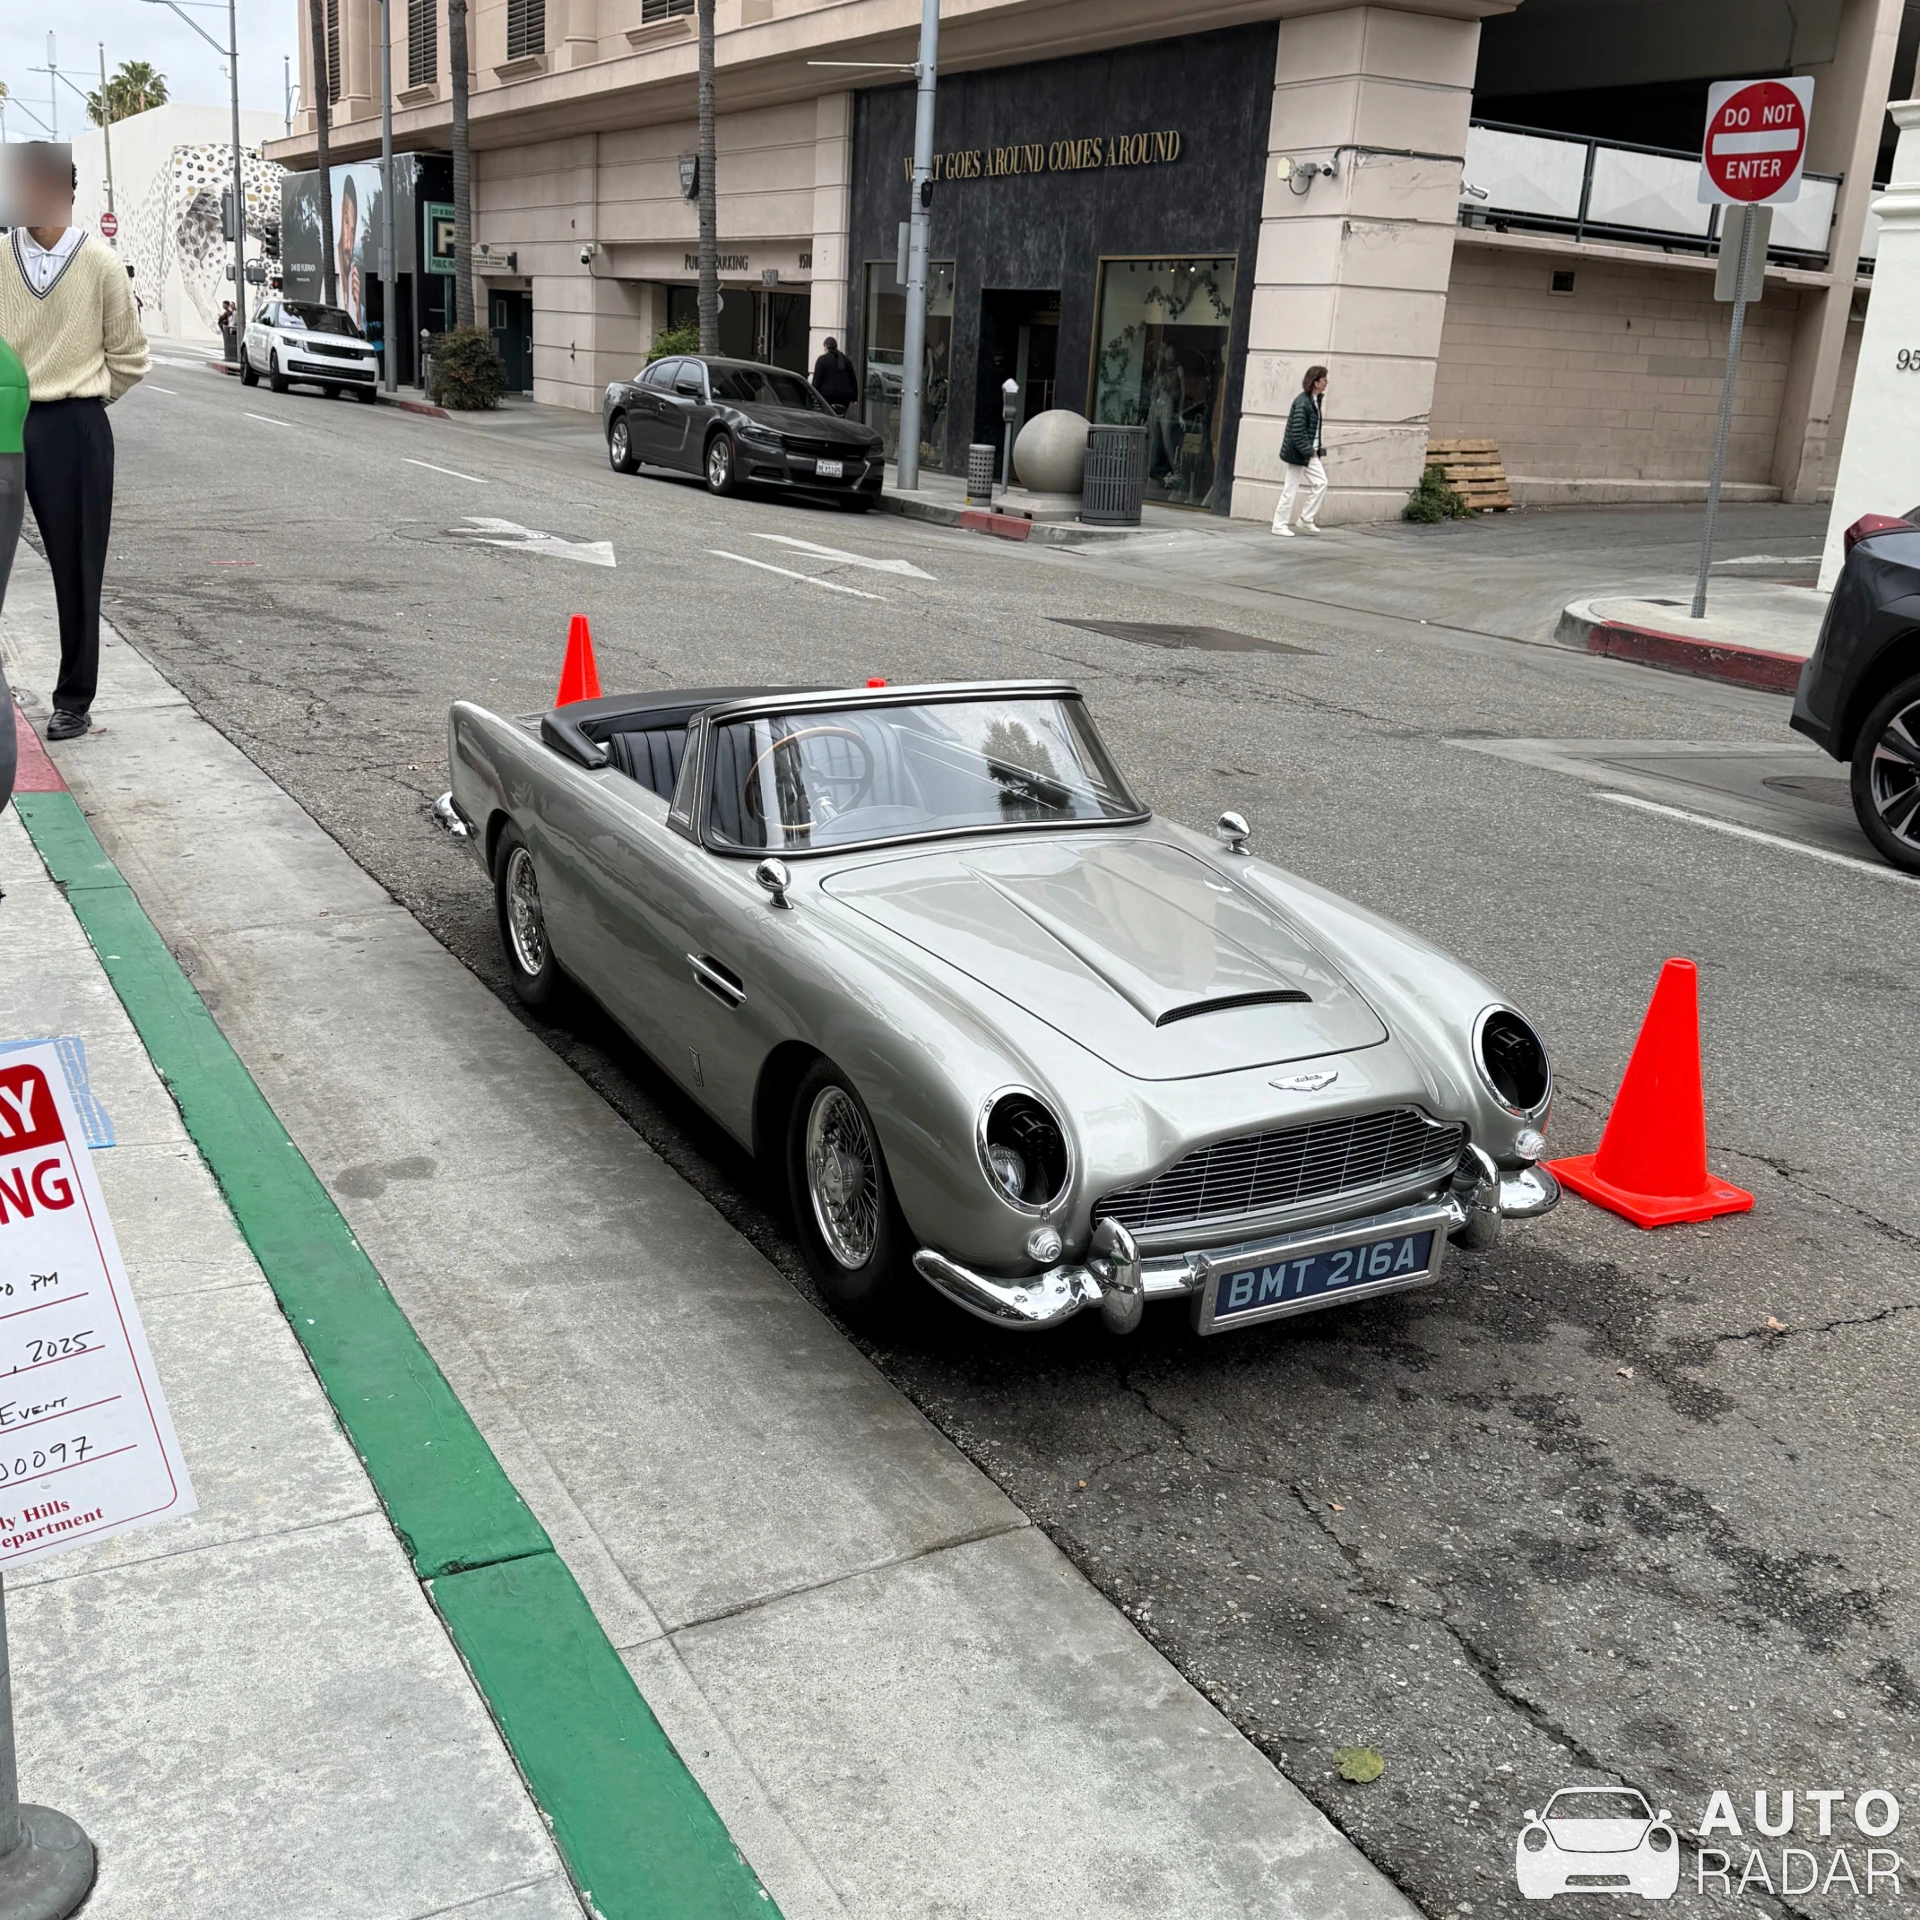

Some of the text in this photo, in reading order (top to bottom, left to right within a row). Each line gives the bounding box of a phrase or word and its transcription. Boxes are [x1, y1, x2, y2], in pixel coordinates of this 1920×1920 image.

[1724, 104, 1796, 127] DO NOT
[903, 130, 1180, 182] WT GOES AROUND COMES AROUND
[1725, 159, 1781, 180] ENTER
[437, 221, 456, 254] P
[716, 254, 749, 271] ARKING
[1896, 348, 1920, 371] 95
[30, 1271, 59, 1292] PM
[1228, 1237, 1415, 1308] BMT 216A
[25, 1330, 94, 1363] 2025
[22, 1499, 70, 1523] Hills
[0, 1507, 104, 1549] epartment
